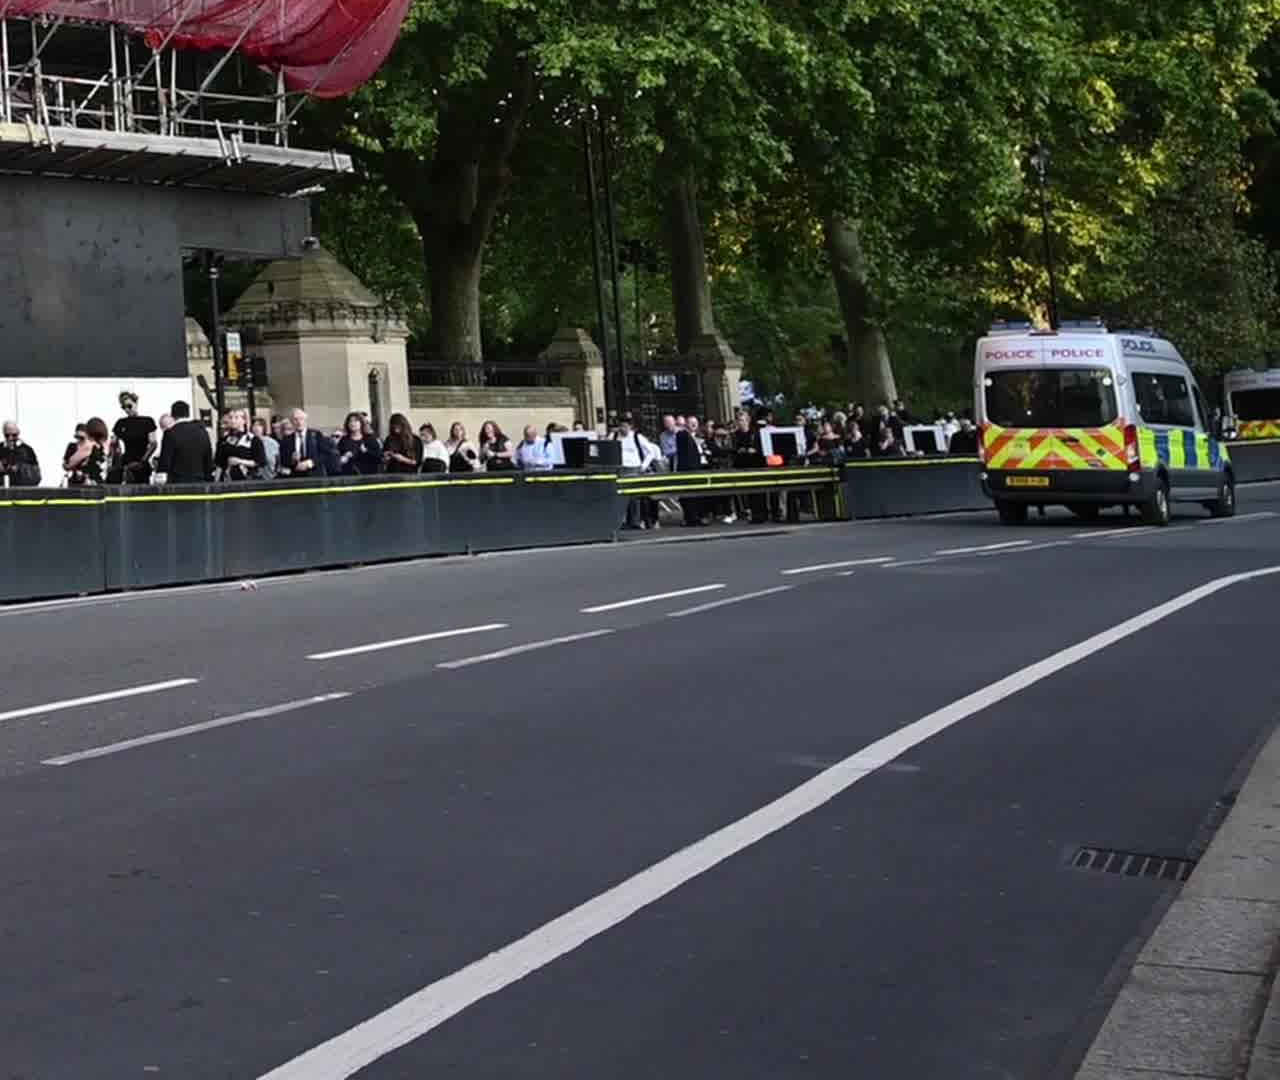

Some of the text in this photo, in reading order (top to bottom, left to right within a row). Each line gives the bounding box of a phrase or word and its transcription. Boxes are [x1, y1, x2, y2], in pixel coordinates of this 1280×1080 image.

[1120, 338, 1156, 353] POLICE
[985, 349, 1036, 360] POLICE
[1051, 348, 1104, 358] POLICE
